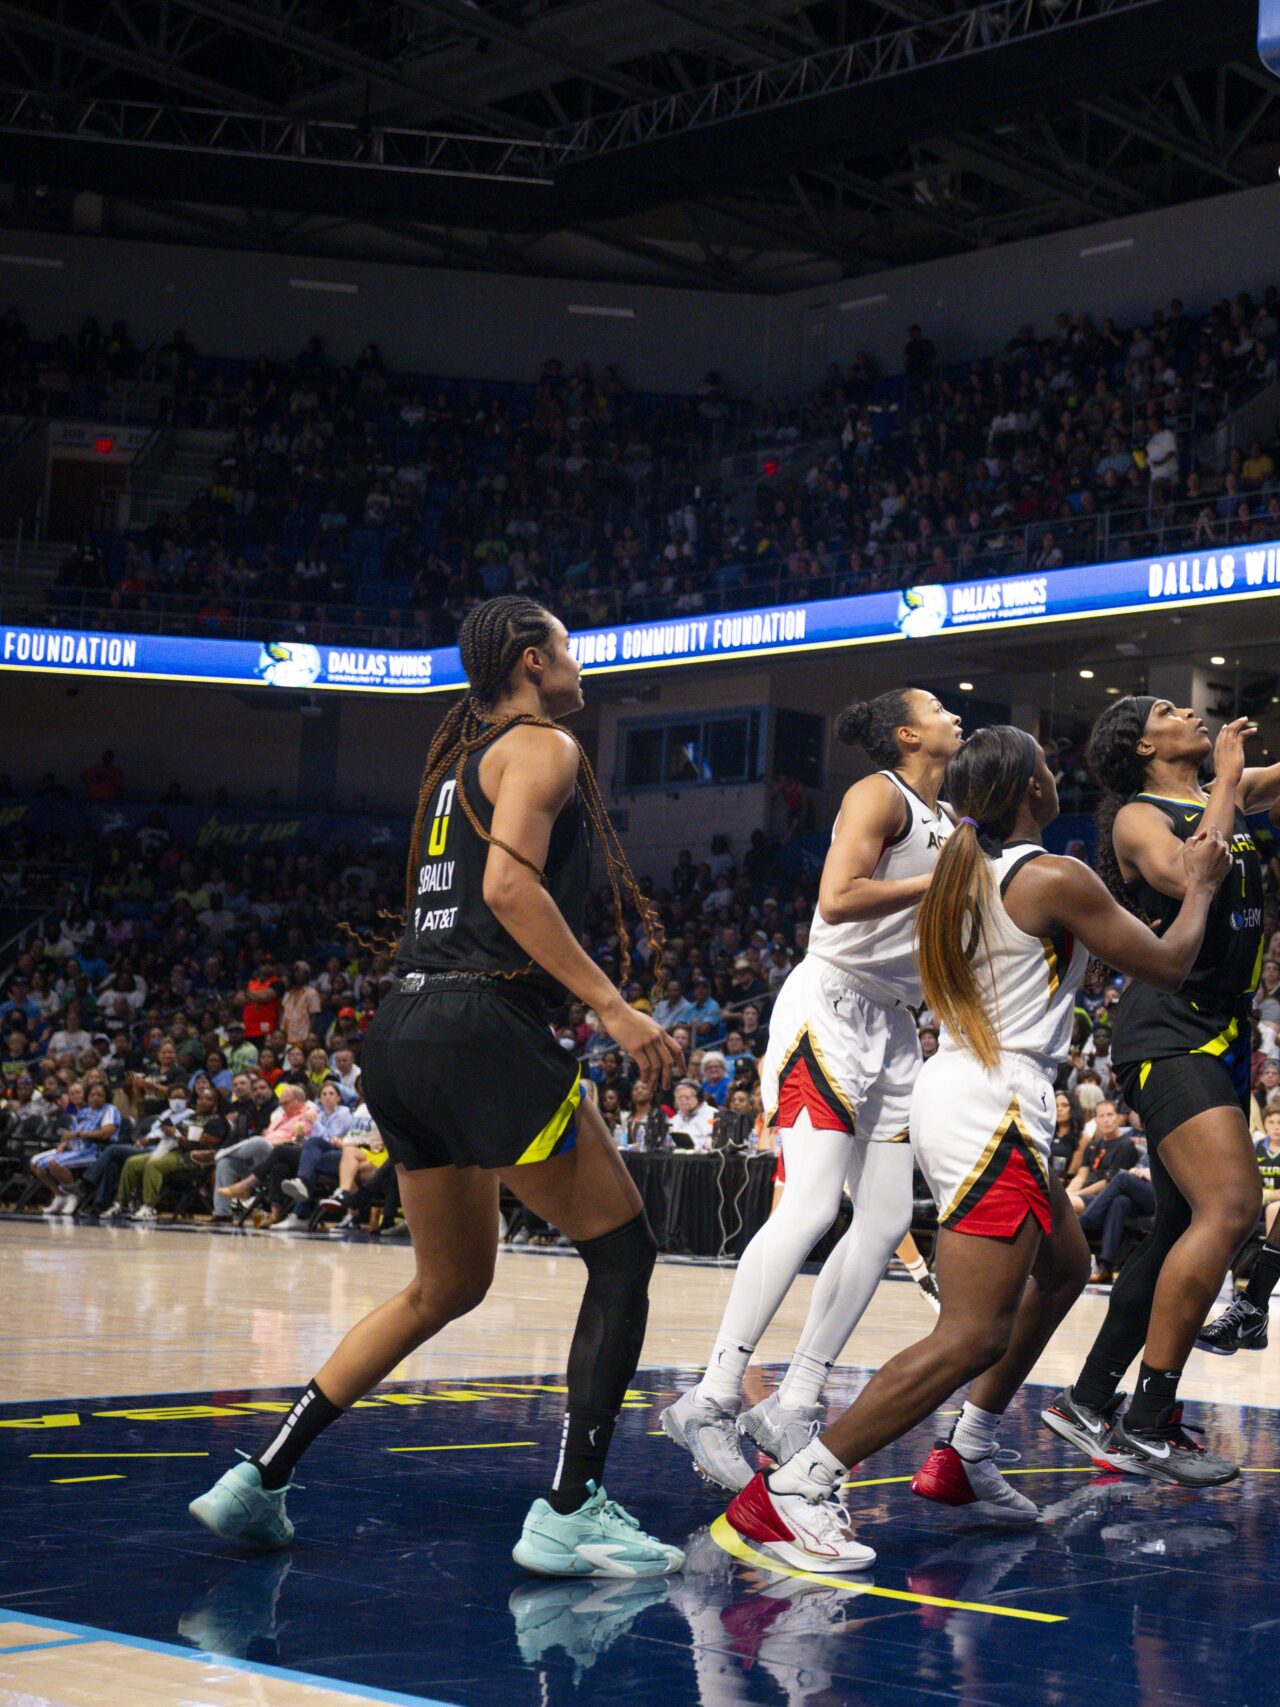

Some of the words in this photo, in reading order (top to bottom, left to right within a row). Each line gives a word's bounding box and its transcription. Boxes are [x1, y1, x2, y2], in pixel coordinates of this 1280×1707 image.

[1148, 555, 1235, 599] DALLAS
[952, 584, 1002, 615] DALLAS
[1002, 578, 1048, 608] WINGS
[4, 632, 137, 668] FOUNDATION
[622, 621, 708, 659] COMMUNITY
[713, 609, 806, 649] FOUNDATION
[328, 651, 387, 676] DALLAS
[388, 654, 432, 677] WINGS
[428, 779, 457, 856] 0
[420, 906, 459, 933] AT&T
